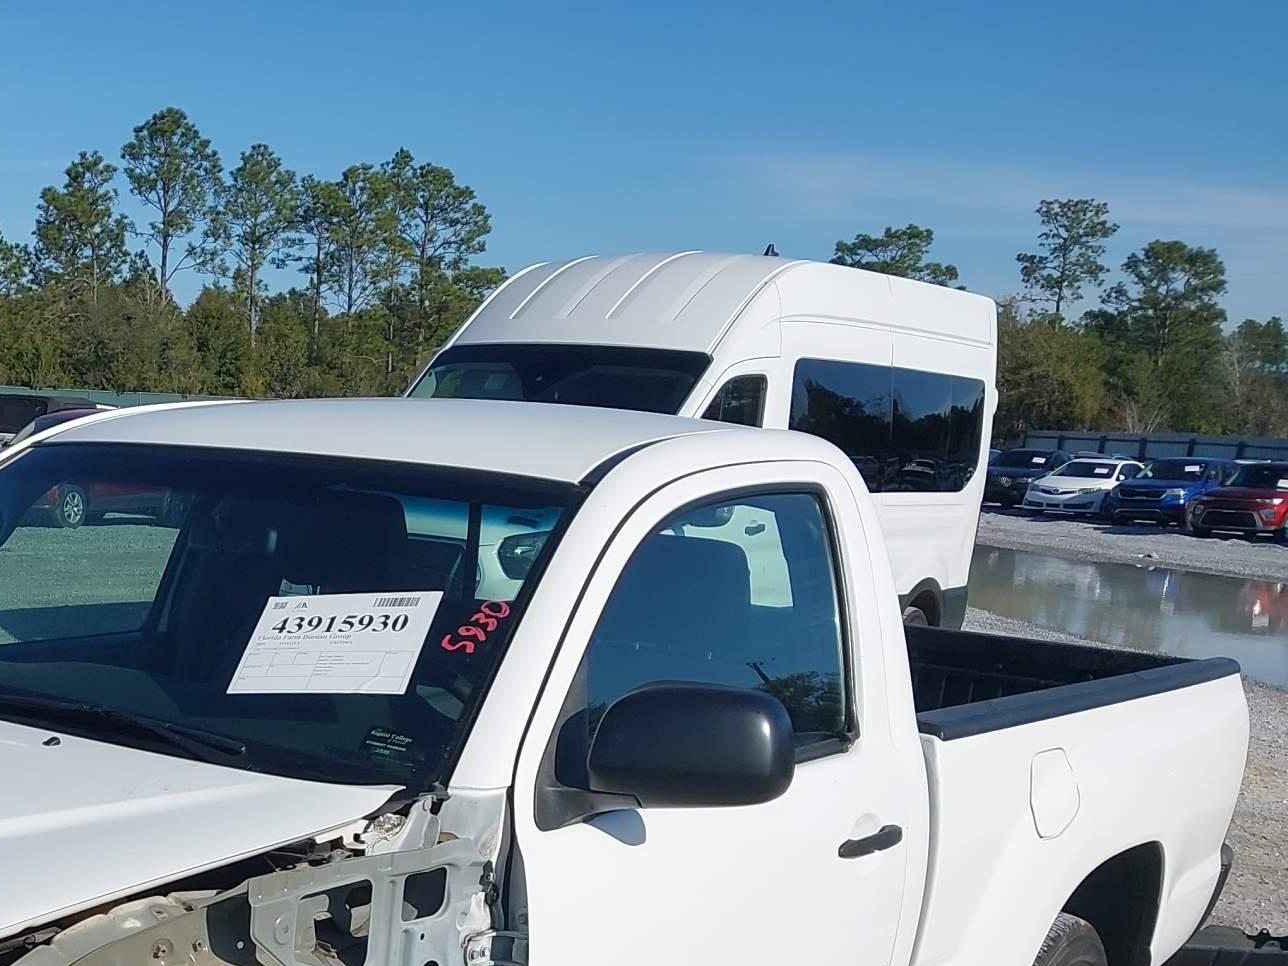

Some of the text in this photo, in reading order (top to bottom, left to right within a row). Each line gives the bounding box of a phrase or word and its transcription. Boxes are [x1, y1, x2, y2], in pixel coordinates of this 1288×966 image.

[272, 613, 409, 634] 43915930
[441, 600, 510, 653] 5930
[329, 633, 352, 642] Group
